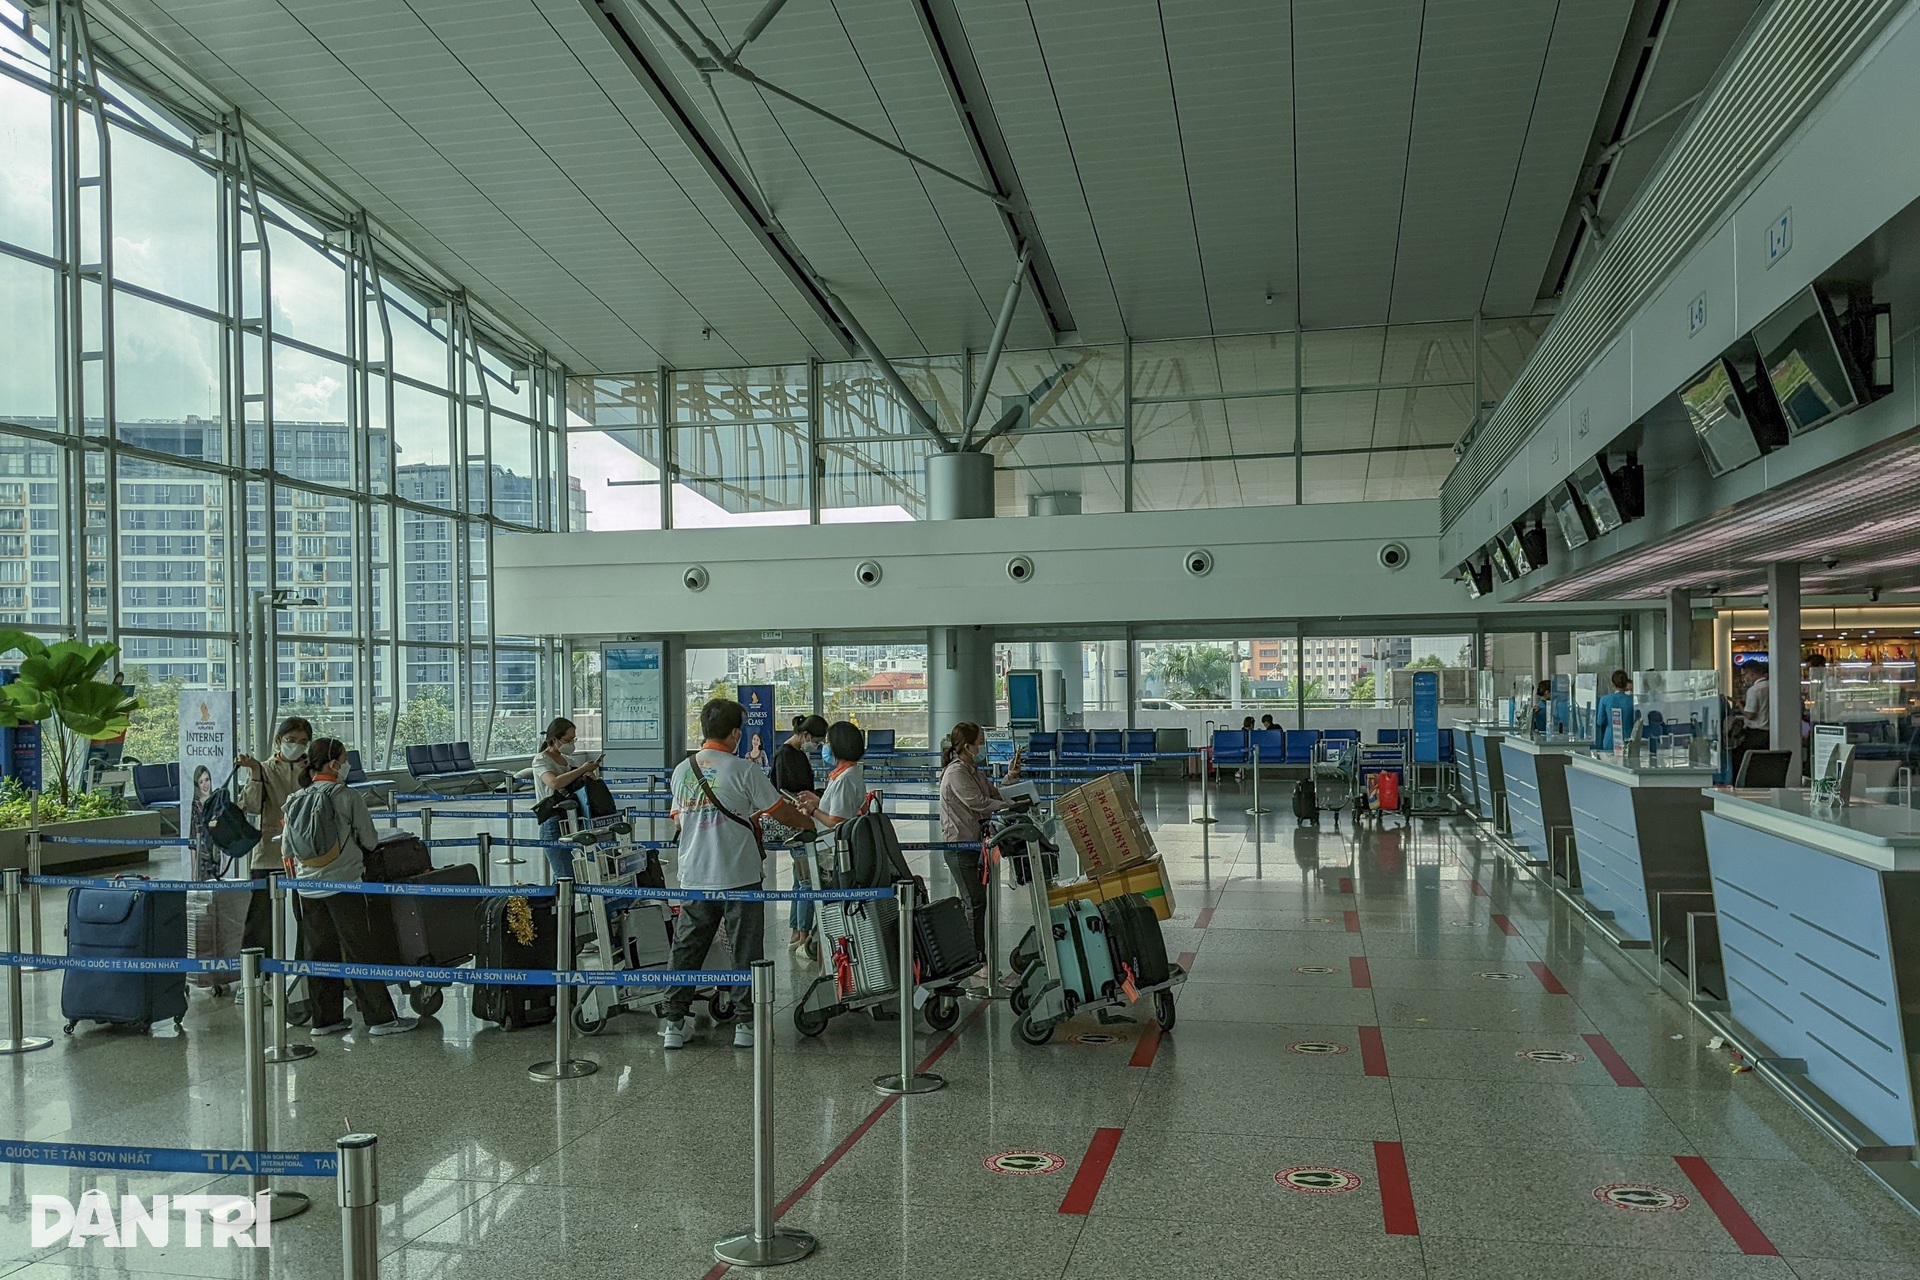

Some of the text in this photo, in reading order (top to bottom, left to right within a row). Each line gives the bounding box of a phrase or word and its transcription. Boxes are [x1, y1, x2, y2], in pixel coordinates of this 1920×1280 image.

[762, 631, 775, 639] EXIT
[747, 718, 764, 726] CLASS
[186, 730, 224, 743] INTERNET
[186, 745, 224, 757] CHECK-IN
[106, 880, 127, 888] TIA
[383, 884, 405, 893] TIA
[591, 886, 614, 894] KHÔNG
[615, 886, 633, 895] QUỐC
[634, 886, 642, 896] TẾ
[642, 888, 655, 896] TÂN
[656, 888, 671, 897] SƠN
[671, 889, 688, 898] NHẤT
[702, 891, 727, 900] TIA
[799, 891, 849, 899] INTERNATIONAL
[850, 890, 878, 898] AIRPORT
[12, 955, 35, 964] CẢNG
[36, 956, 57, 965] HÀNG
[59, 957, 86, 968] KHÔNG
[87, 958, 110, 969] QUỐC
[112, 958, 121, 969] TẾ
[123, 959, 139, 969] TÂN
[140, 961, 157, 969] SƠN
[158, 959, 179, 969] NHẤT
[198, 960, 229, 970] TIA
[281, 961, 311, 973] TIA
[344, 967, 586, 983] CẢNG HÀNG KHÔNG QUỐC TẾ TÂN SƠN NHẤT TIA
[623, 974, 751, 983] TAN SON NHAT INTERNATIONA
[6, 1144, 253, 1172] QUỐC TẾ TÂN SƠN NHẤT TIA
[314, 1158, 338, 1170] TAN
